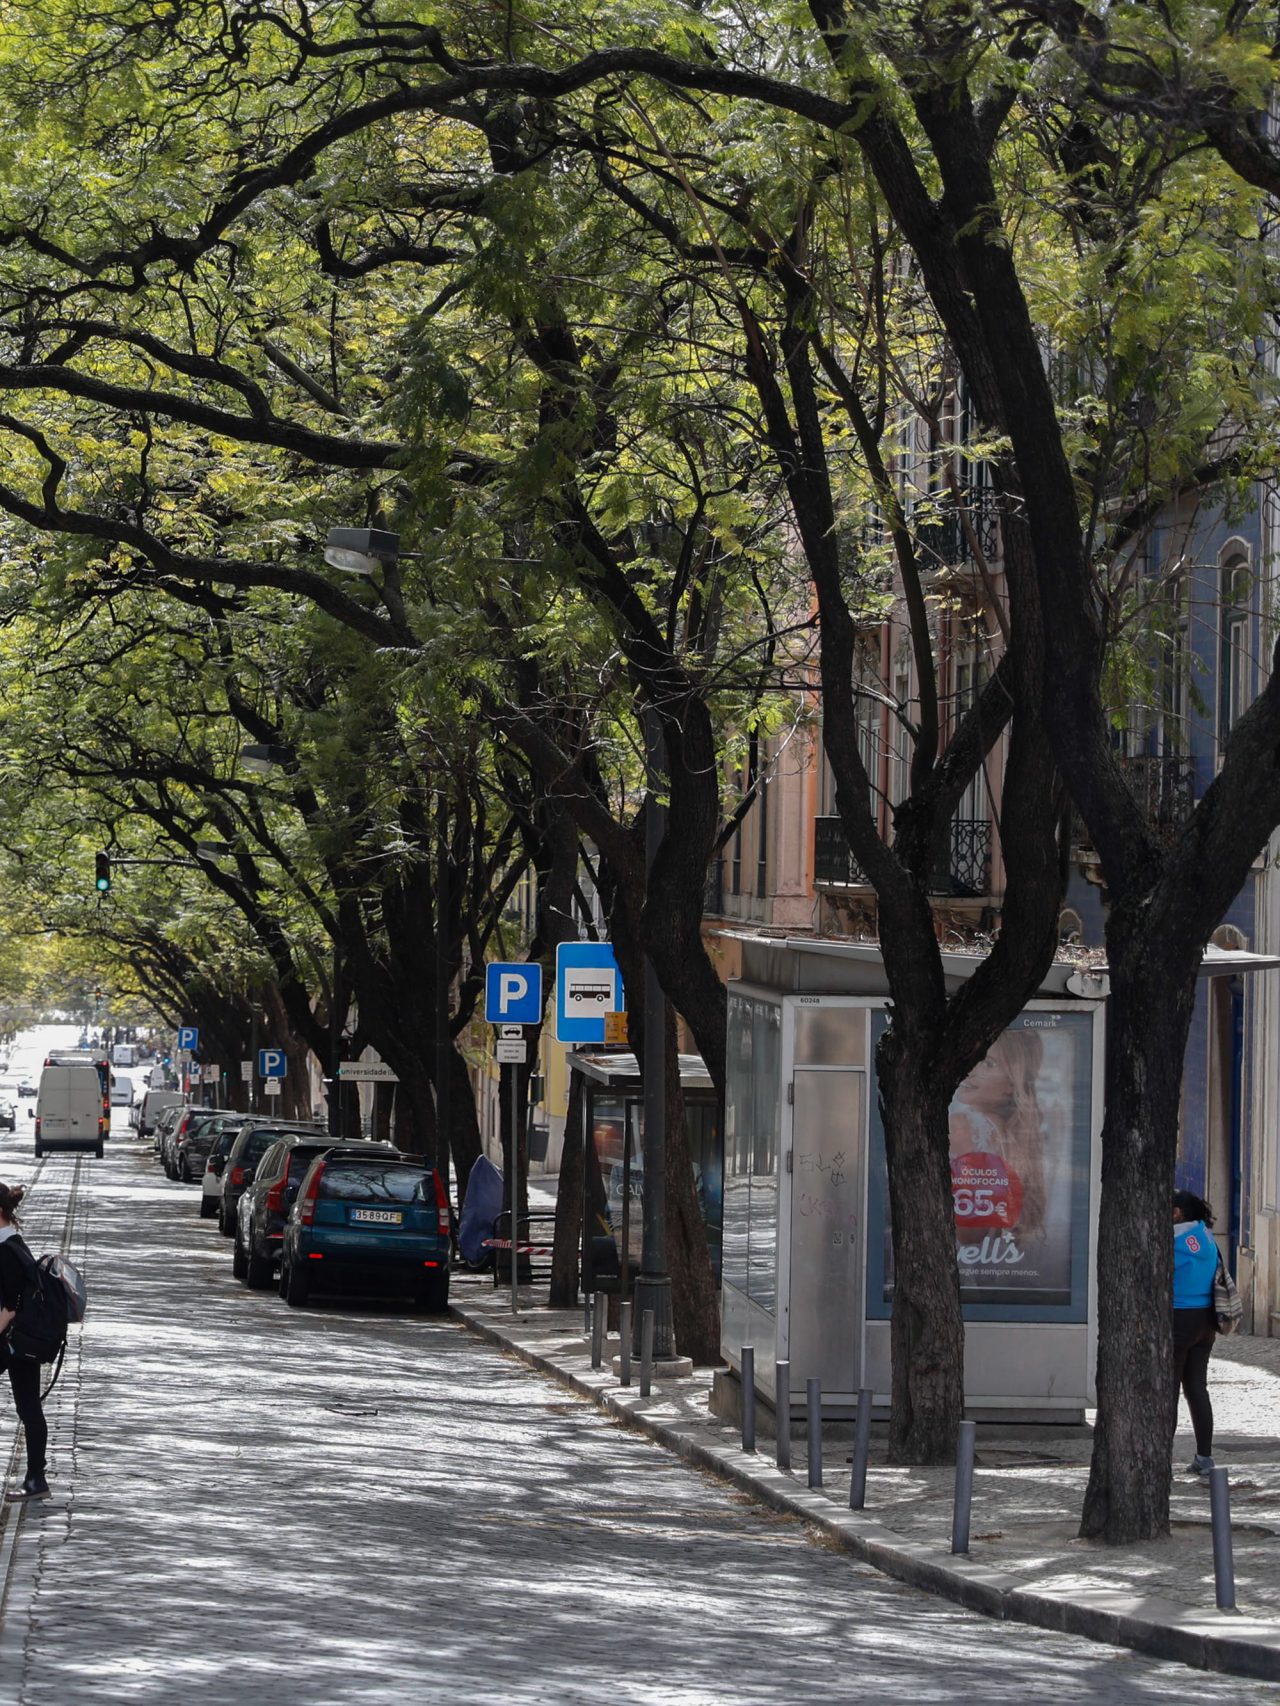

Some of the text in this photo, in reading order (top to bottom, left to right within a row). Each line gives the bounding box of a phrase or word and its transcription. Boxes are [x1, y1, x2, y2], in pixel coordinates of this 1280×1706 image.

[499, 973, 528, 1014] P
[1023, 1019, 1057, 1027] Cemark
[182, 1030, 194, 1047] P
[191, 1061, 200, 1073] P
[264, 1052, 281, 1075] P
[341, 1068, 387, 1076] universidade
[961, 1167, 998, 1176] ÓCULOS
[1186, 1235, 1200, 1253] 8
